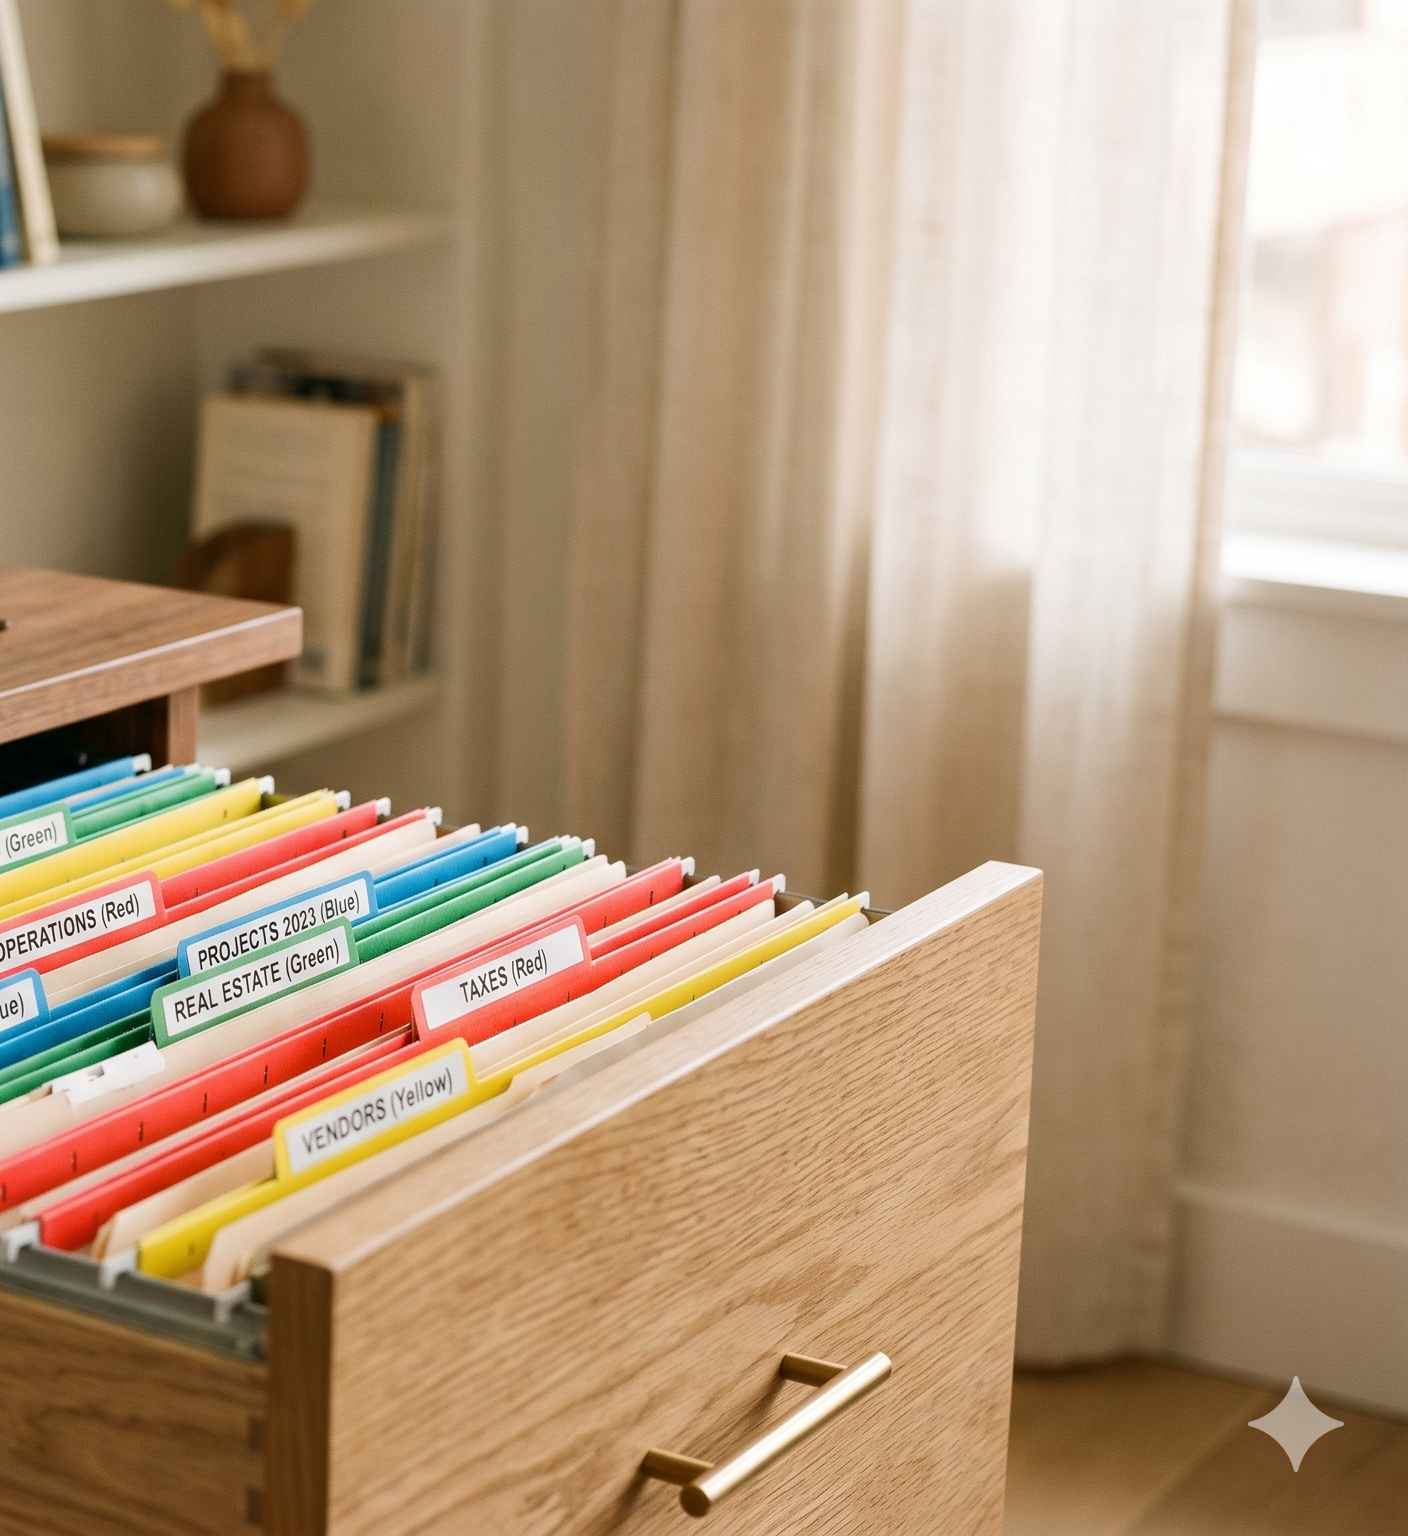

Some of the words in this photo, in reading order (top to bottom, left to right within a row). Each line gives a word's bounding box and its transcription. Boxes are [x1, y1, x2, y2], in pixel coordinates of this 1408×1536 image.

[4, 821, 59, 859] (Green)
[101, 893, 140, 929] (Red)
[197, 921, 280, 971] PROJECTS
[282, 906, 317, 937] 2023
[320, 889, 361, 924] (Blue)
[174, 988, 219, 1023] REAL
[221, 961, 282, 1003] ESTATE
[285, 938, 340, 983] (Green)
[459, 965, 508, 1003] TAXES
[511, 948, 549, 987] (Red)
[301, 1098, 386, 1155] VENDORS
[390, 1068, 454, 1120] (Yellow)
